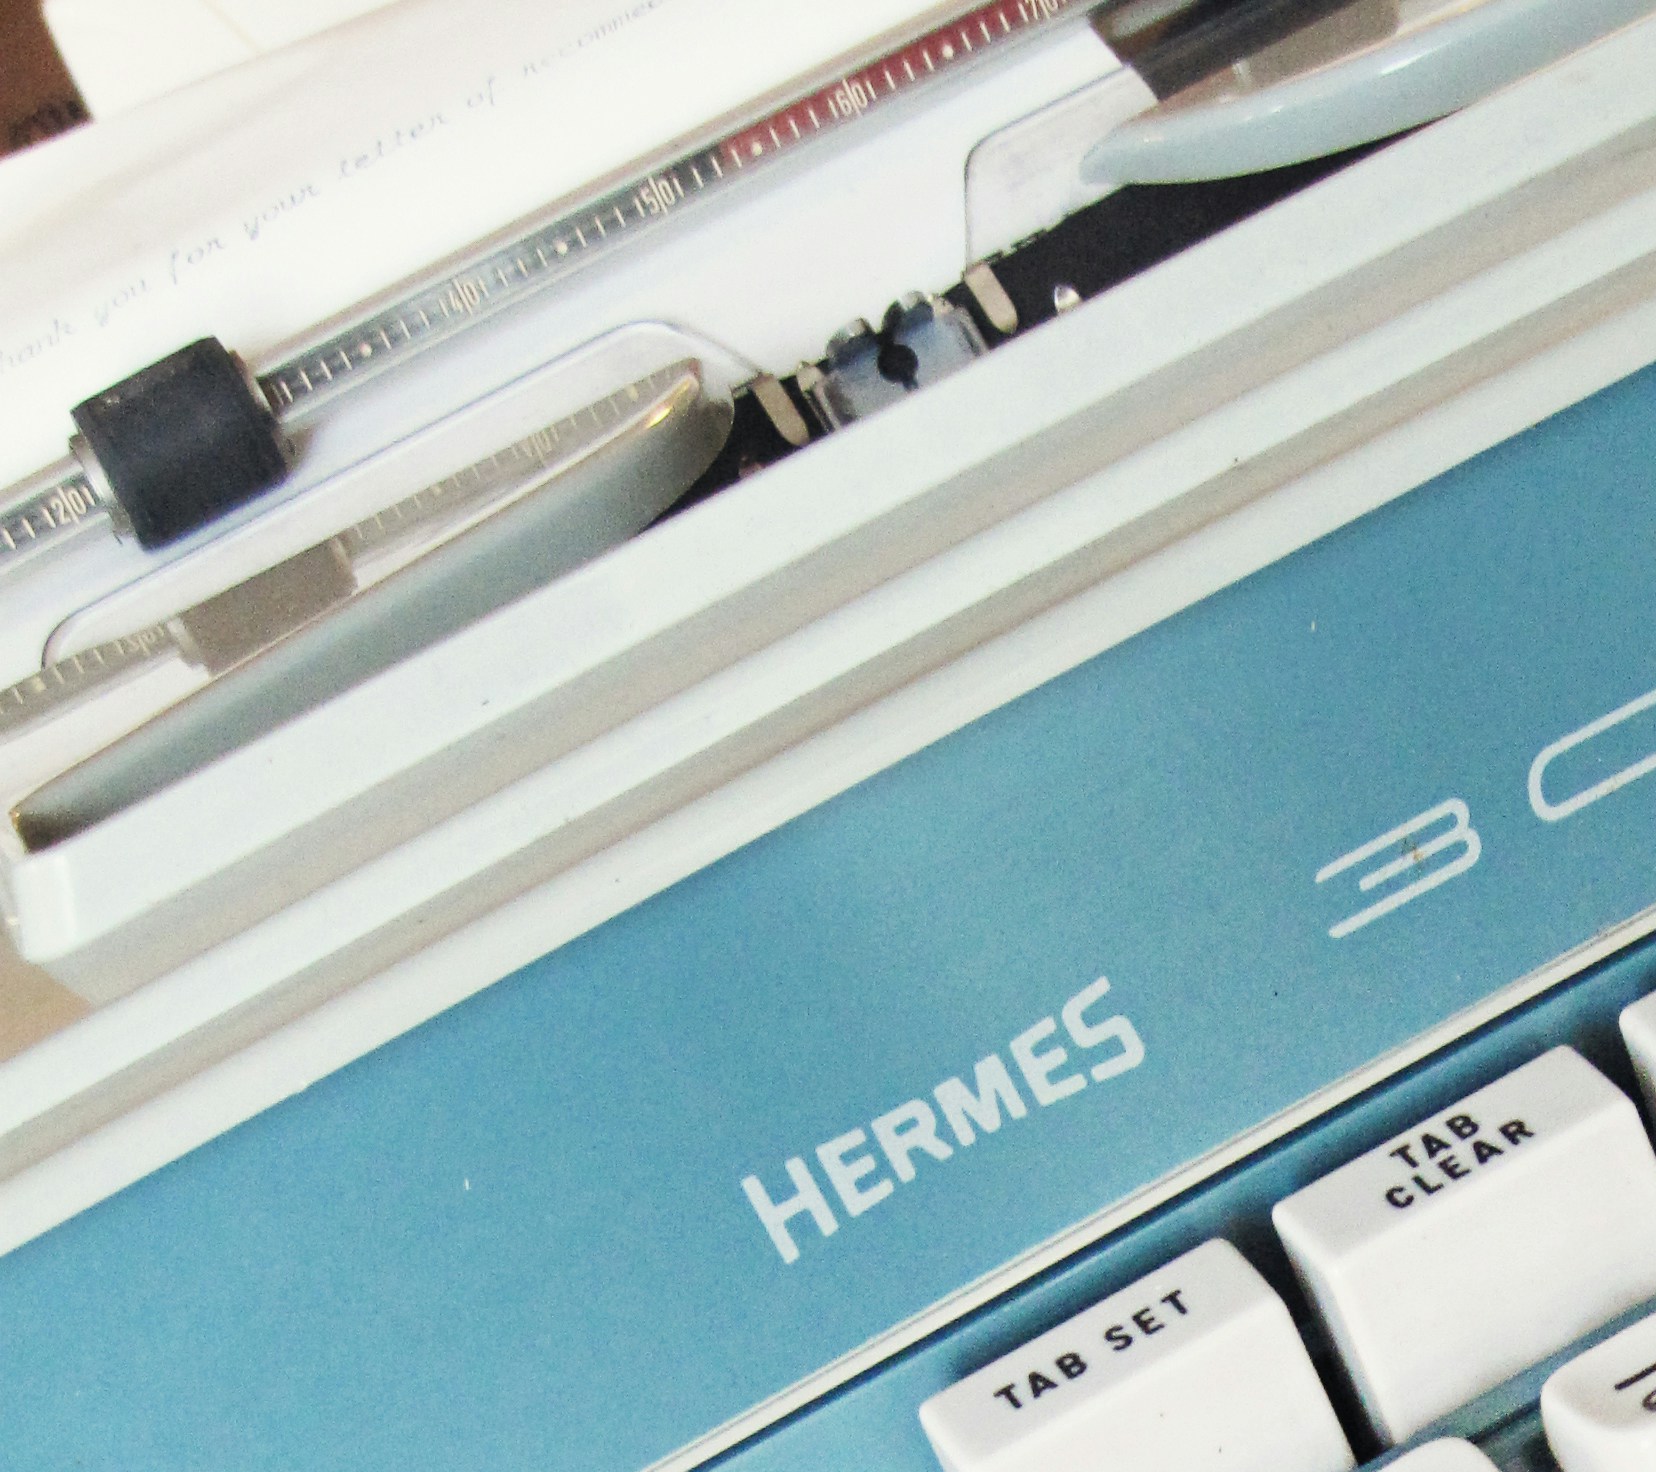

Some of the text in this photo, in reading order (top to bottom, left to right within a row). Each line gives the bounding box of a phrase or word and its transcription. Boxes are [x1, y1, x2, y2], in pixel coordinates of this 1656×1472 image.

[741, 975, 1147, 1264] HERMES
[1384, 1117, 1536, 1212] CLEAR
[1389, 1112, 1481, 1172] TAB
[994, 1289, 1194, 1411] TAB SET
